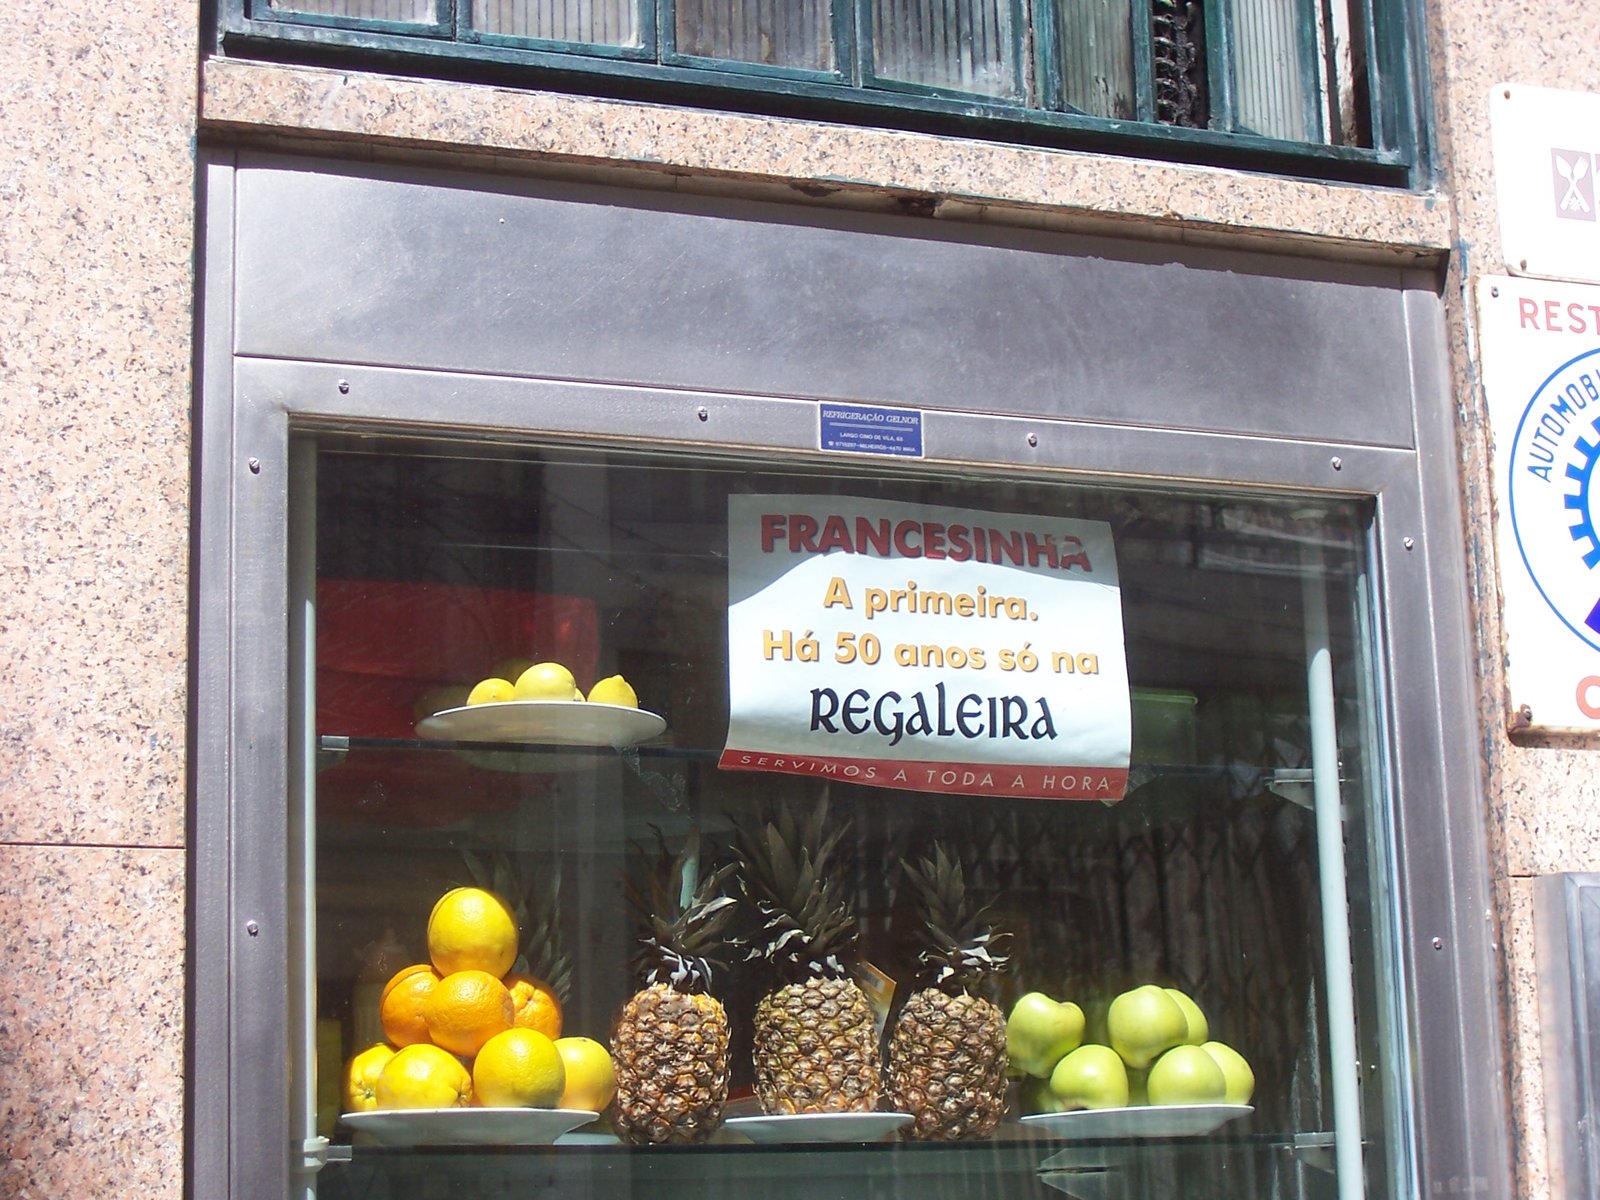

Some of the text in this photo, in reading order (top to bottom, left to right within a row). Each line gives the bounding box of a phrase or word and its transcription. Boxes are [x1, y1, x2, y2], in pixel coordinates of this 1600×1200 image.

[822, 409, 920, 425] REFRIGERAÇÃO GELNOR
[760, 513, 1093, 572] FRANCESINHA
[823, 576, 1039, 621] A primeira.
[763, 629, 1099, 674] Há 50 anos só na
[739, 755, 1111, 792] SERVIMOS A TODA A HORA
